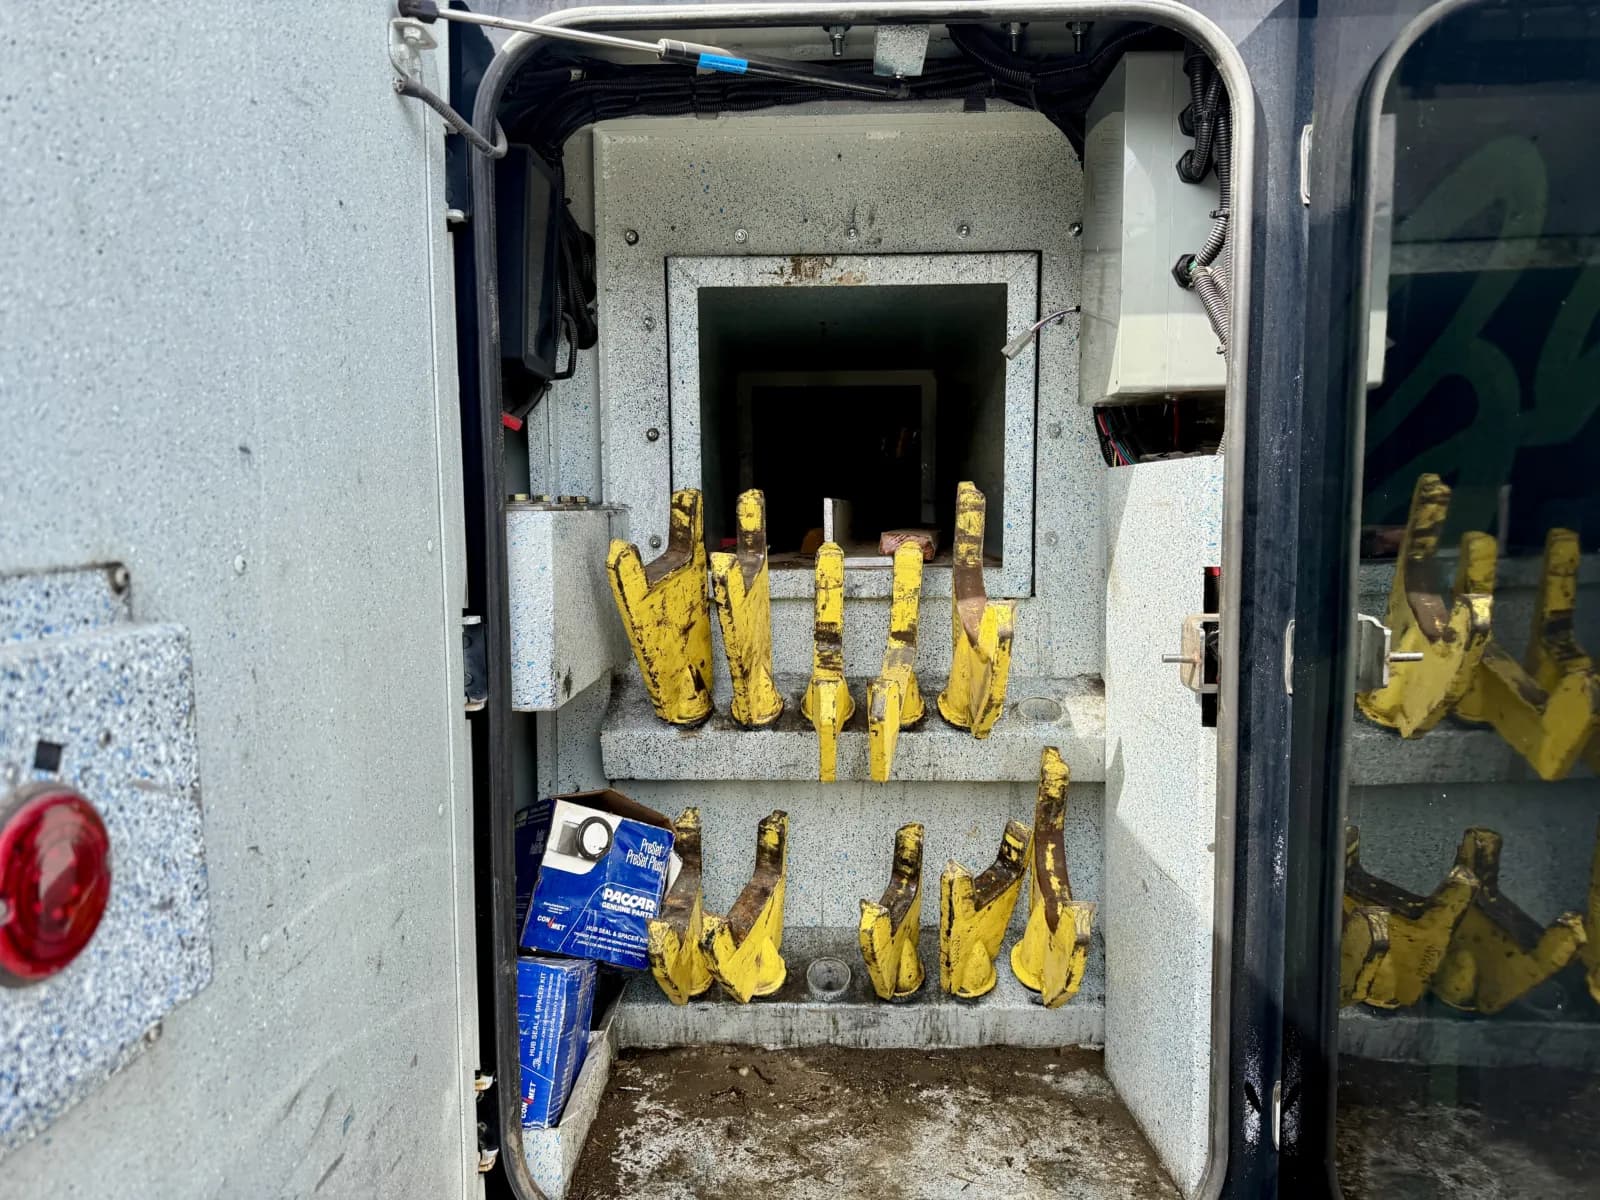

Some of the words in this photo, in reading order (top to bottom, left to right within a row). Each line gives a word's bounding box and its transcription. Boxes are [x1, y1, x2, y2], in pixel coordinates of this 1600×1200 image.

[640, 838, 662, 857] PreSet
[626, 849, 648, 869] PreSet
[648, 856, 662, 872] Plus
[603, 888, 655, 911] PACCAR
[602, 902, 630, 914] GENUINE
[632, 909, 654, 918] PARTS
[599, 927, 611, 936] SEAL
[618, 932, 639, 941] SPACER
[539, 972, 547, 984] KIT
[535, 985, 545, 1013] SPACER
[531, 1021, 539, 1040] SEAL
[528, 1041, 536, 1057] HUB
